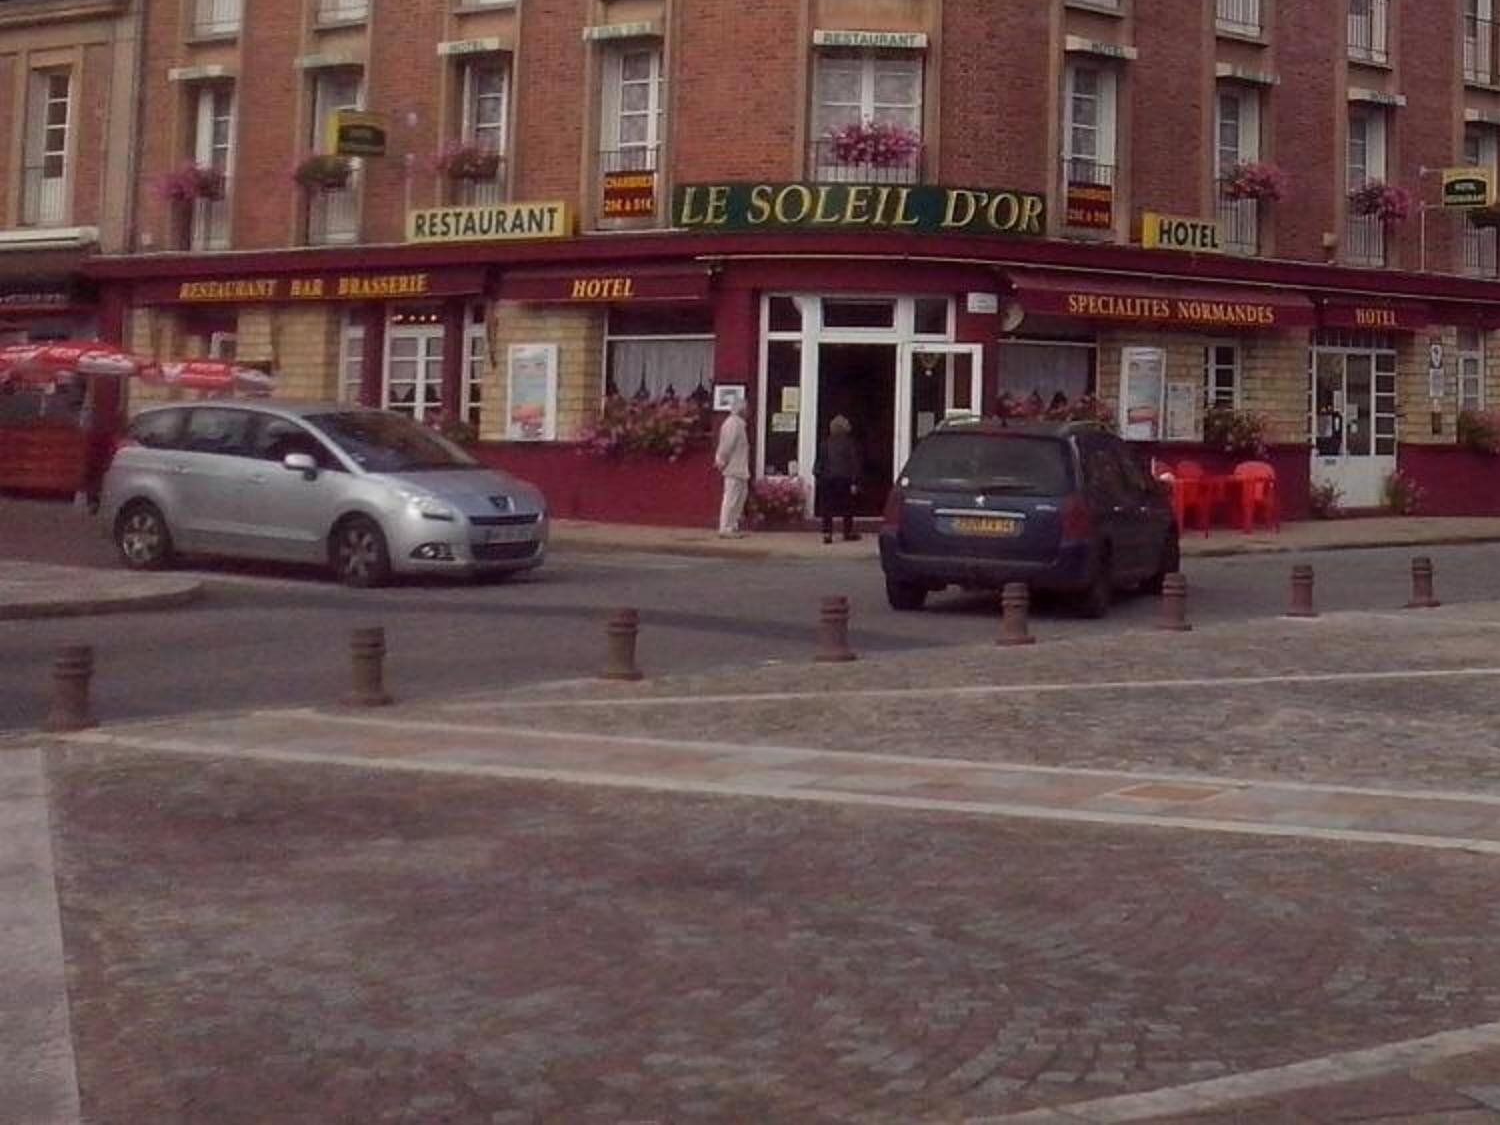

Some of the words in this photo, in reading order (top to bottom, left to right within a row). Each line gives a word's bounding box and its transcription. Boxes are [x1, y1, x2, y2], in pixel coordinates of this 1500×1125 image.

[823, 32, 915, 47] RESTAURANT
[414, 207, 559, 238] RESTAURANT
[681, 186, 730, 224] LE
[747, 184, 919, 224] SOLEIL
[940, 189, 1044, 233] D'OR
[1159, 219, 1219, 249] HOTEL
[179, 279, 278, 299] RESTAURANT
[290, 278, 324, 297] BAR
[338, 273, 429, 296] BRASSERIE
[571, 277, 634, 298] HOTEL
[1068, 293, 1169, 318] SPECIALITES
[1177, 300, 1275, 324] NORMANDES
[1355, 308, 1397, 326] HOTEL
